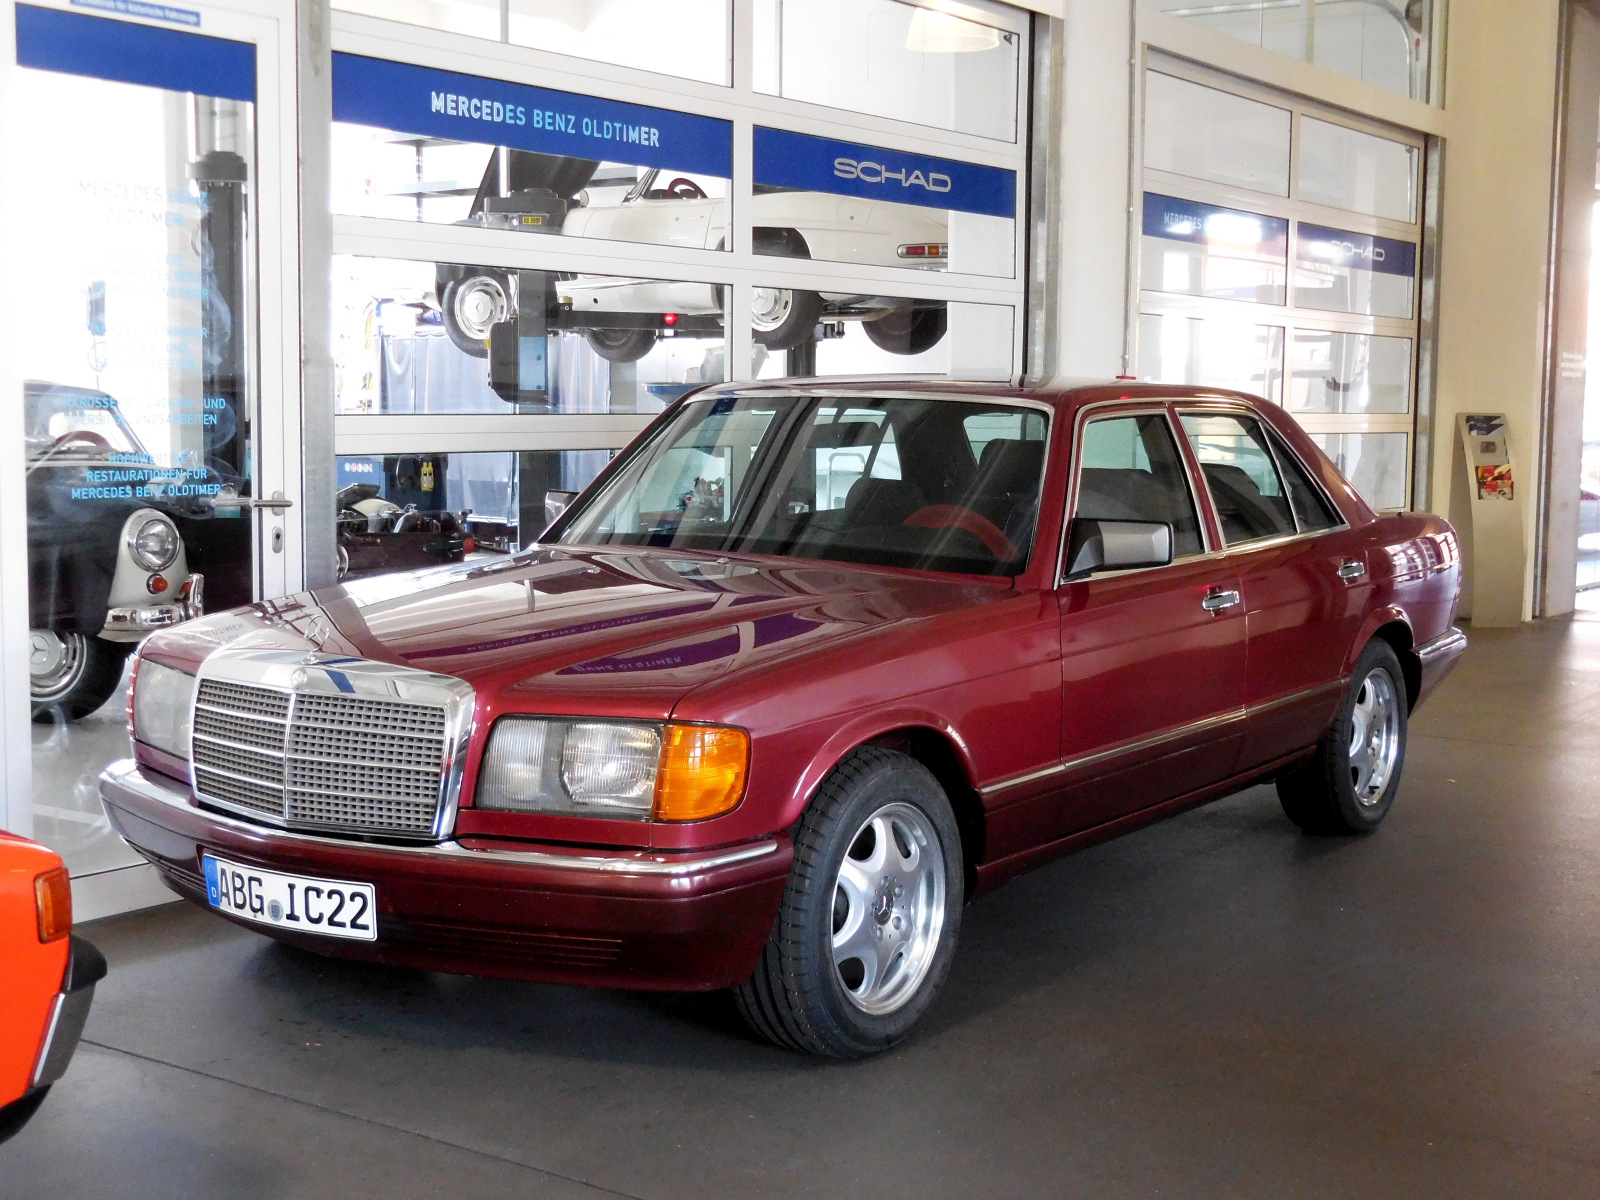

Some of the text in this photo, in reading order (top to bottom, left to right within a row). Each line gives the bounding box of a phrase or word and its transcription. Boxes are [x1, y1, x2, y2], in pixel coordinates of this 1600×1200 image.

[430, 91, 660, 148] MERCEDES BENZ OLDTIMER
[833, 157, 952, 193] SCHAD
[79, 181, 163, 201] MERCEDES
[1163, 211, 1202, 231] MERCEDES
[204, 398, 226, 409] UND
[86, 469, 183, 483] RESTAURATIONEN
[71, 484, 222, 500] MERCEDES BENZ OLDTIMER
[211, 887, 217, 898] D
[219, 867, 370, 932] ABG IC22
